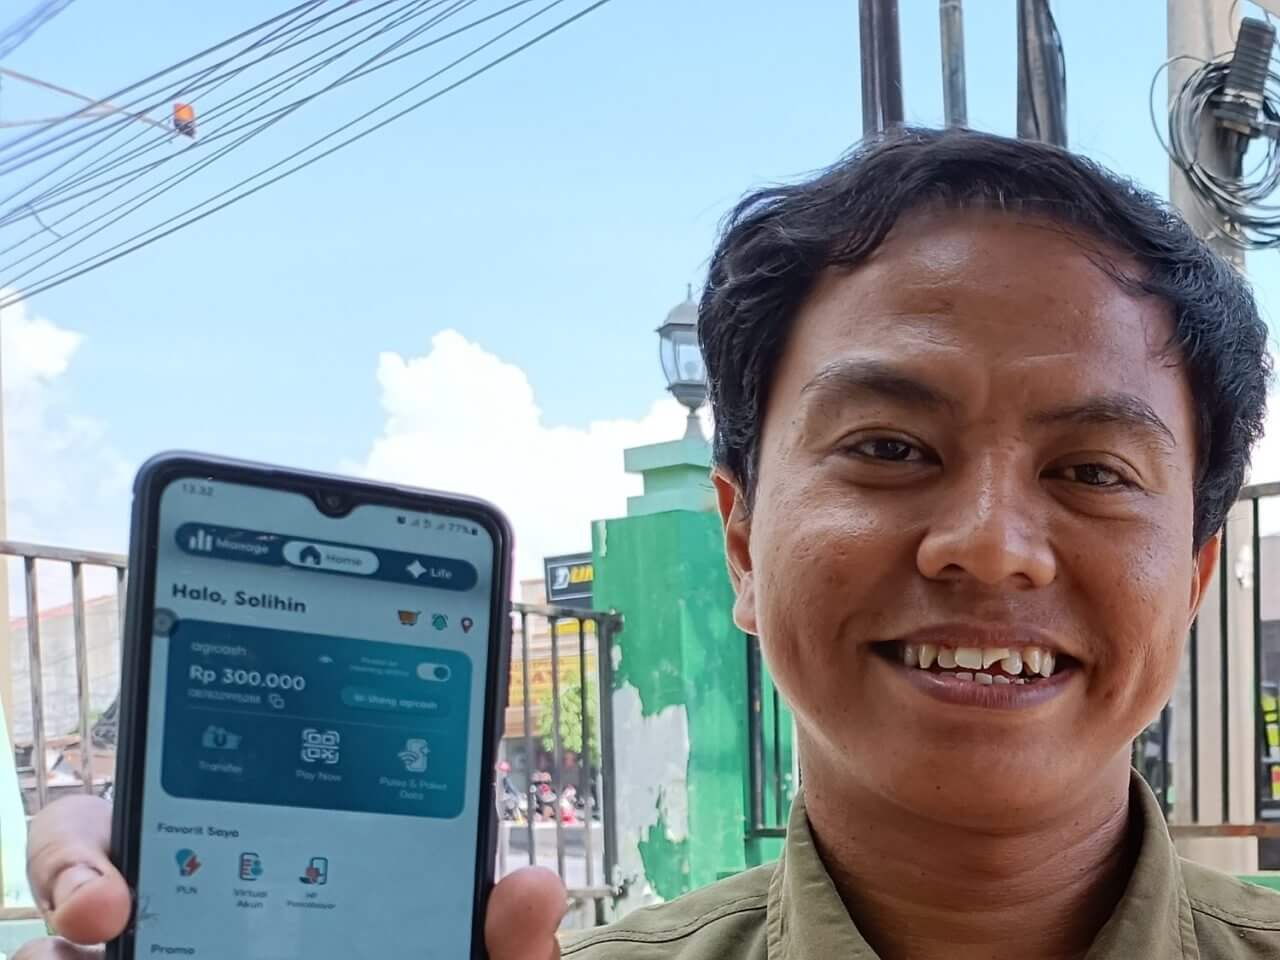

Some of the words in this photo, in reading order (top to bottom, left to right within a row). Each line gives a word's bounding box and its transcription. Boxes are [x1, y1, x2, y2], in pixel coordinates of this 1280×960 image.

[216, 538, 269, 556] Manage
[326, 553, 363, 566] Home
[430, 567, 453, 579] Life
[172, 583, 227, 606] Halo,
[235, 590, 307, 613] Solihin
[189, 664, 216, 685] Rp
[223, 668, 306, 691] 300.000
[157, 822, 204, 836] Favorit
[207, 826, 240, 839] Saya
[176, 886, 198, 895] PLN
[150, 944, 196, 956] Promo
